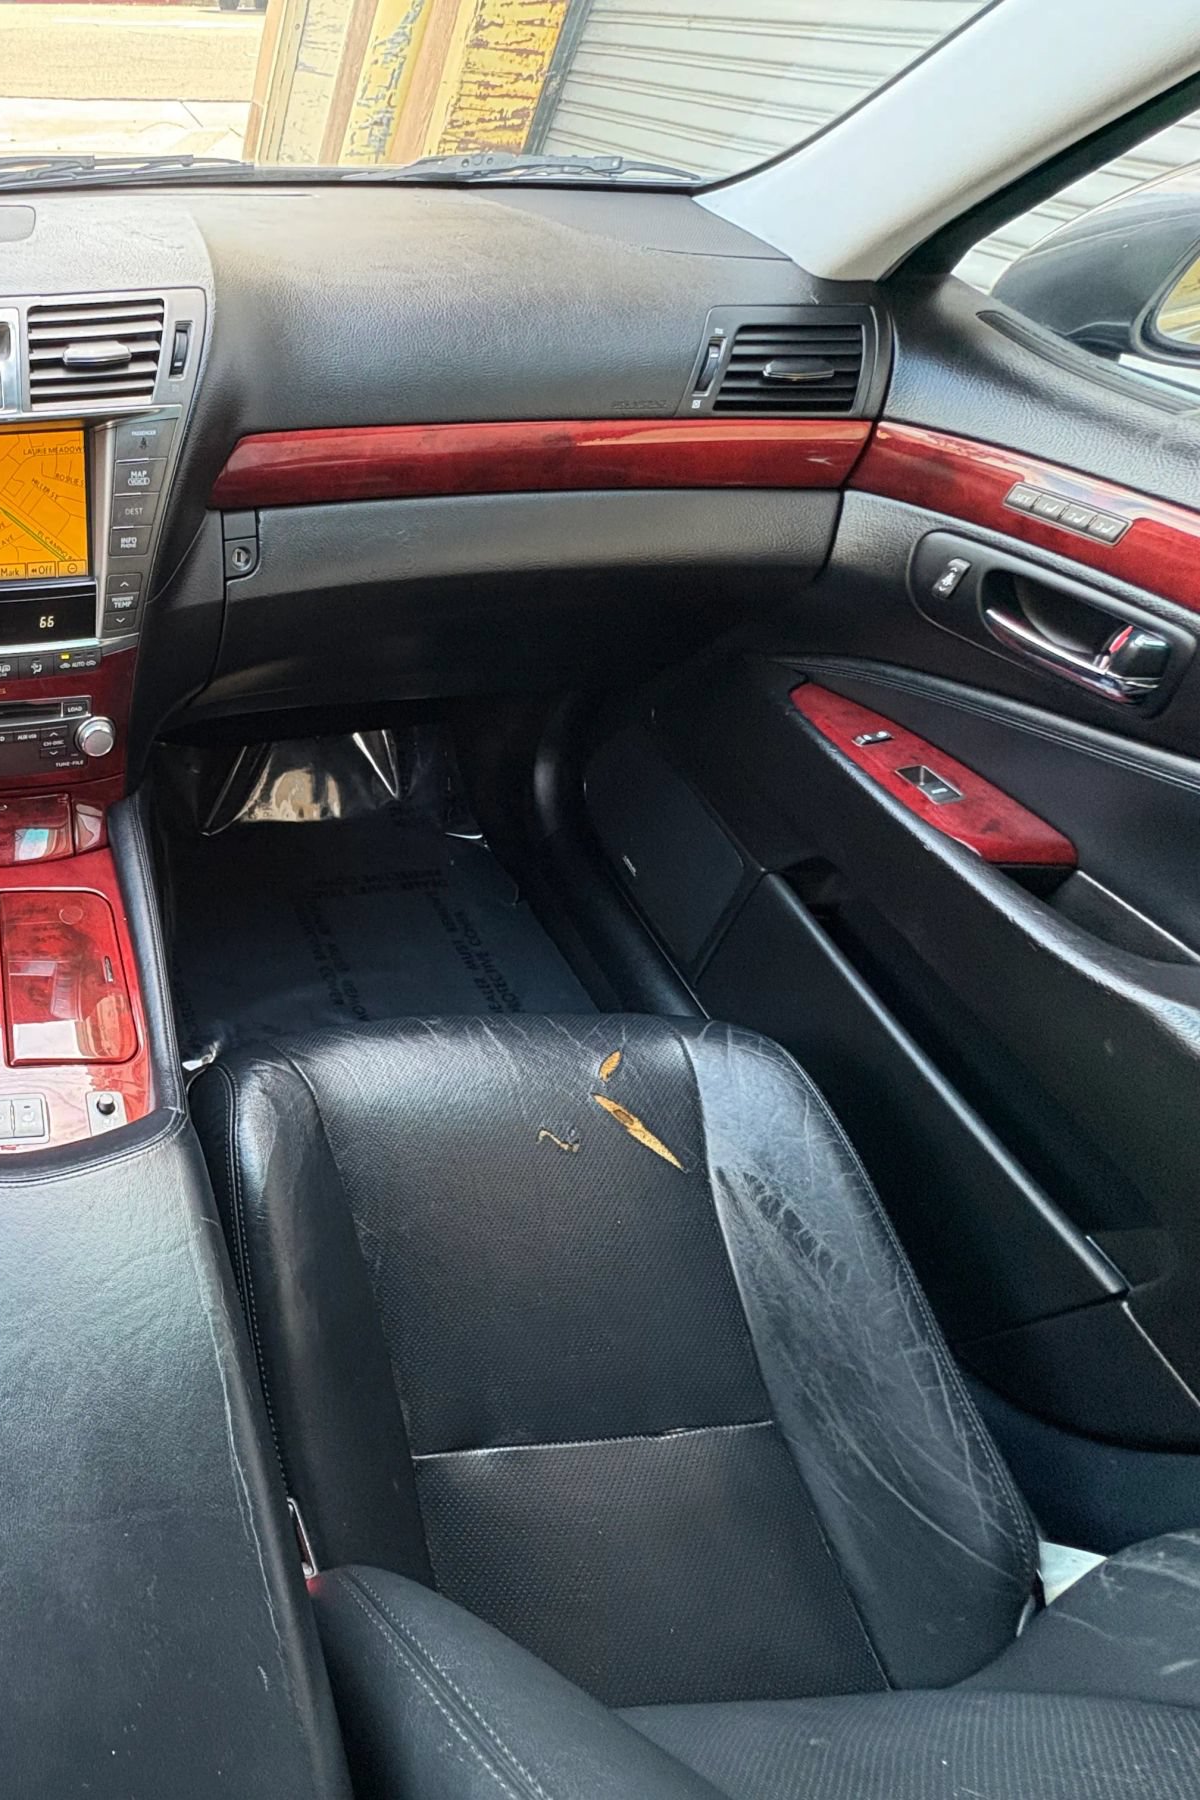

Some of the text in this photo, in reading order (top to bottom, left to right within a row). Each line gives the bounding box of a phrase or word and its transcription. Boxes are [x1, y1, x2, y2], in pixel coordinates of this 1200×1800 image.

[125, 507, 143, 515] DEST
[0, 567, 20, 577] Mark
[38, 566, 52, 575] Off
[113, 601, 133, 609] TEMP
[39, 616, 54, 628] 66
[67, 705, 83, 713] LOAD
